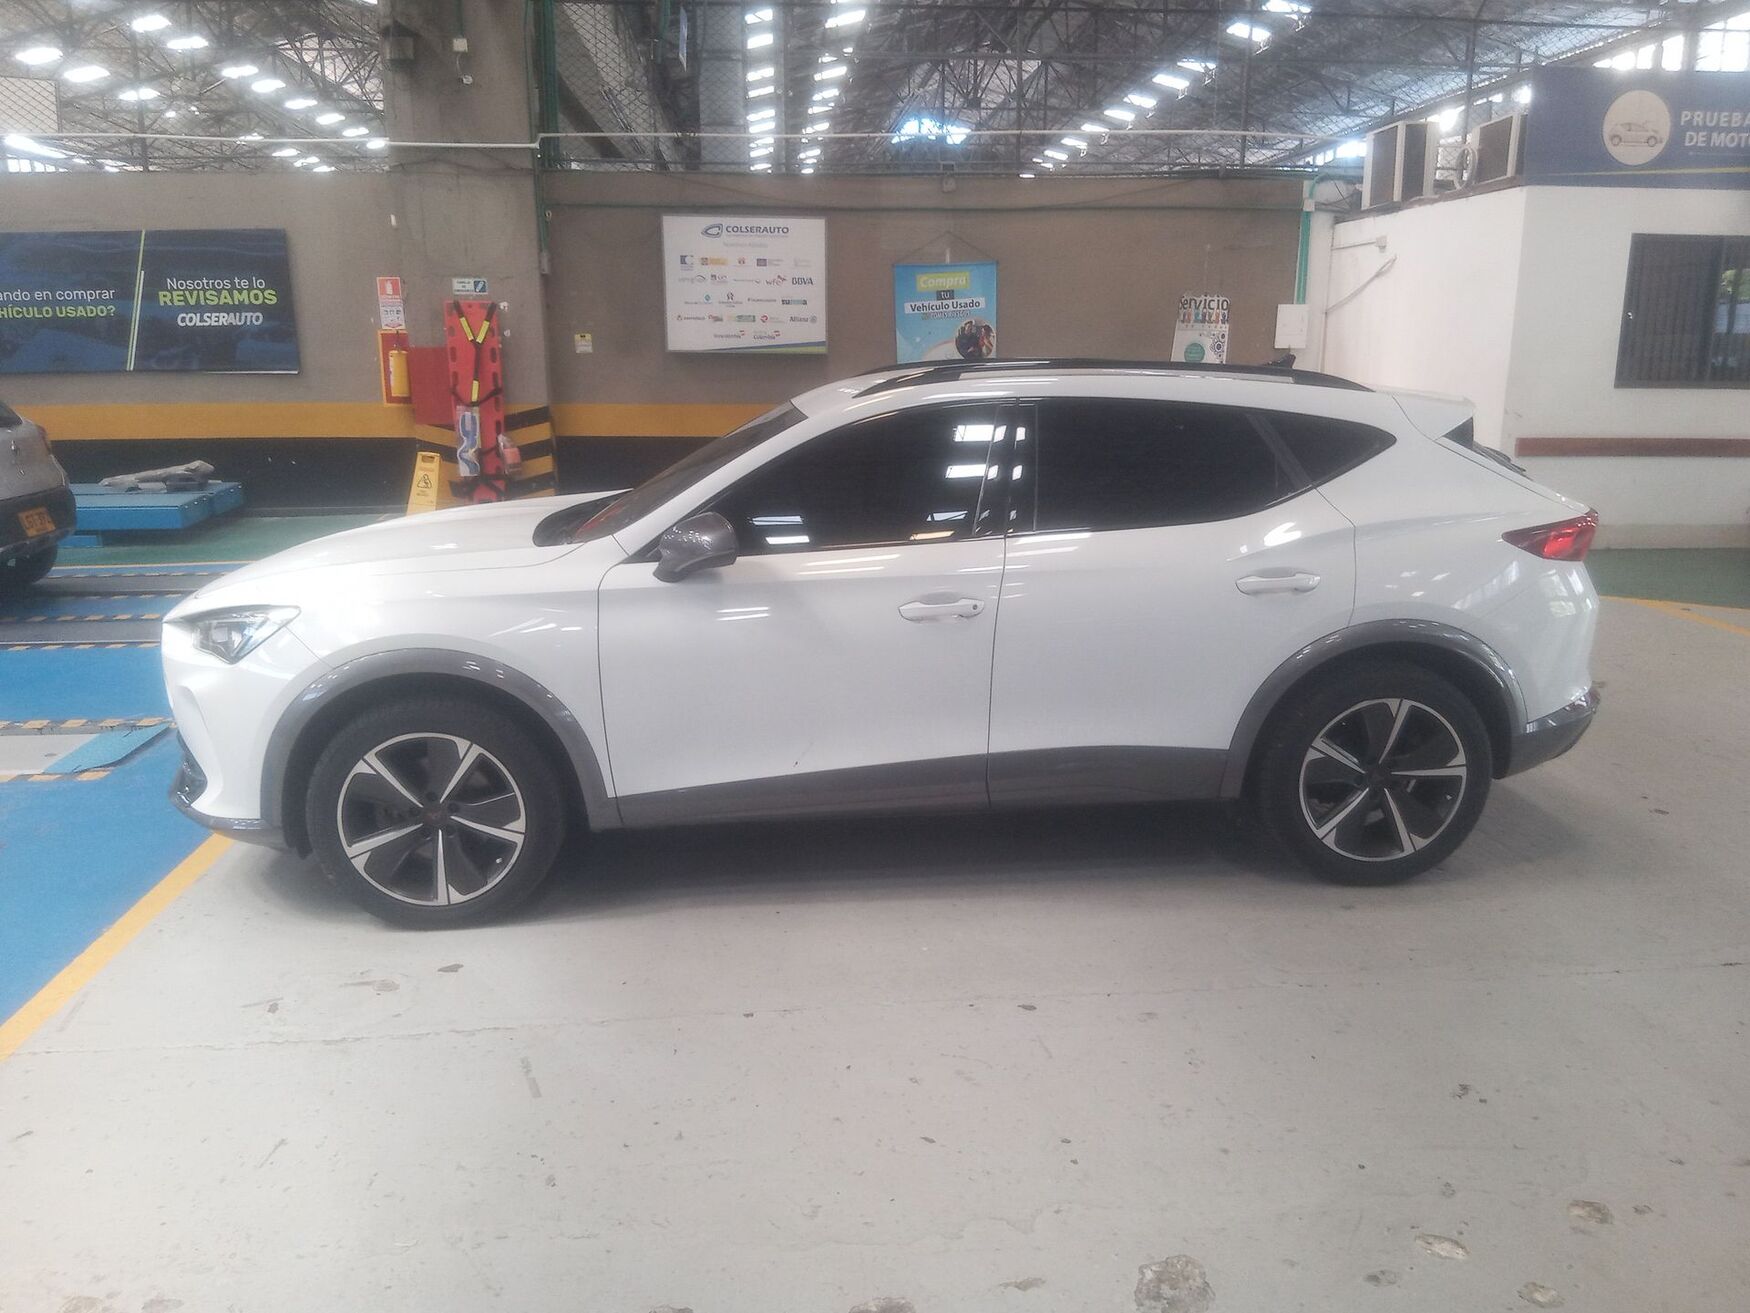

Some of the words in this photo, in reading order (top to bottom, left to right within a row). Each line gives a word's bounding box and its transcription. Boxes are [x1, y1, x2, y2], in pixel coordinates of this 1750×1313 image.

[1684, 131, 1707, 147] DE
[1710, 132, 1750, 148] MOT
[725, 225, 790, 234] COLSERAUTO
[166, 277, 231, 290] Nosotros
[234, 276, 250, 289] te
[252, 275, 266, 289] lo
[791, 276, 814, 286] BBVA
[919, 276, 967, 288] Compra
[34, 290, 52, 300] en
[56, 289, 115, 302] comprar
[158, 289, 278, 306] REVISAMOS
[941, 291, 950, 299] tu
[55, 305, 116, 318] USADO?
[910, 302, 950, 312] Vehículo
[952, 299, 981, 309] Usado
[177, 312, 264, 327] COLSERAUTO
